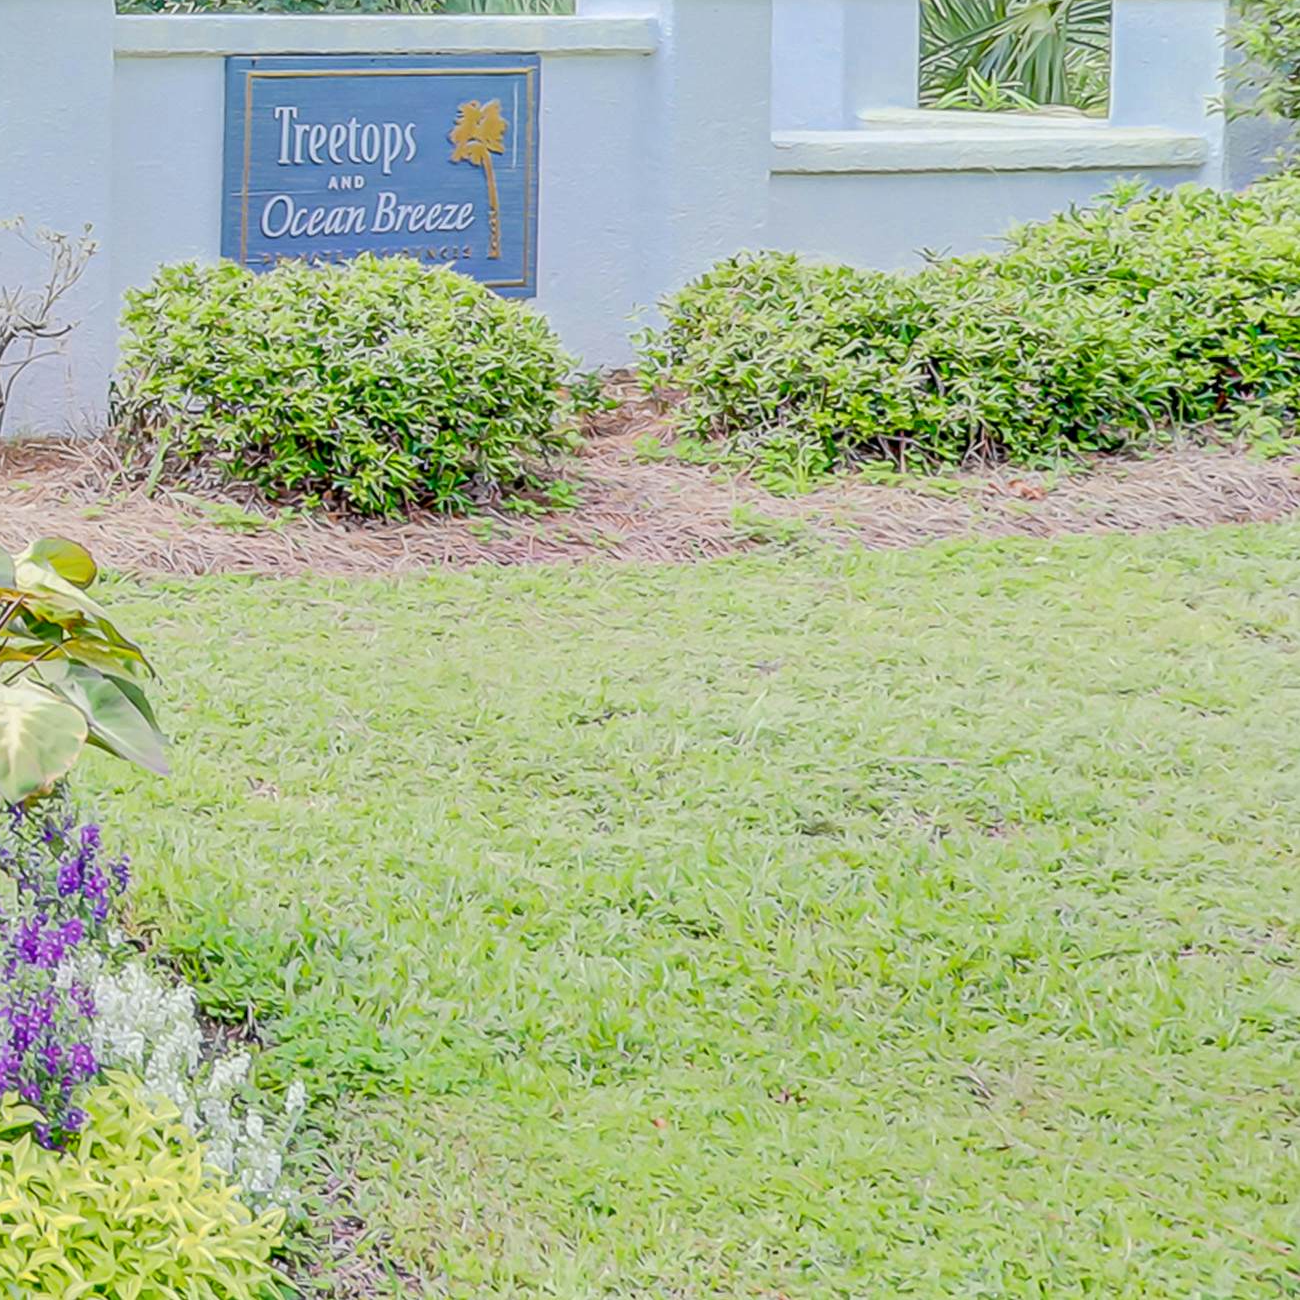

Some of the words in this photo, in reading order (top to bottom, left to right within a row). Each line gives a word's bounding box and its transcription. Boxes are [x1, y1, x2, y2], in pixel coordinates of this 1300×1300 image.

[274, 106, 417, 175] Treetops
[328, 175, 366, 190] AND
[261, 194, 367, 238] Ocean
[370, 191, 475, 232] Breeze
